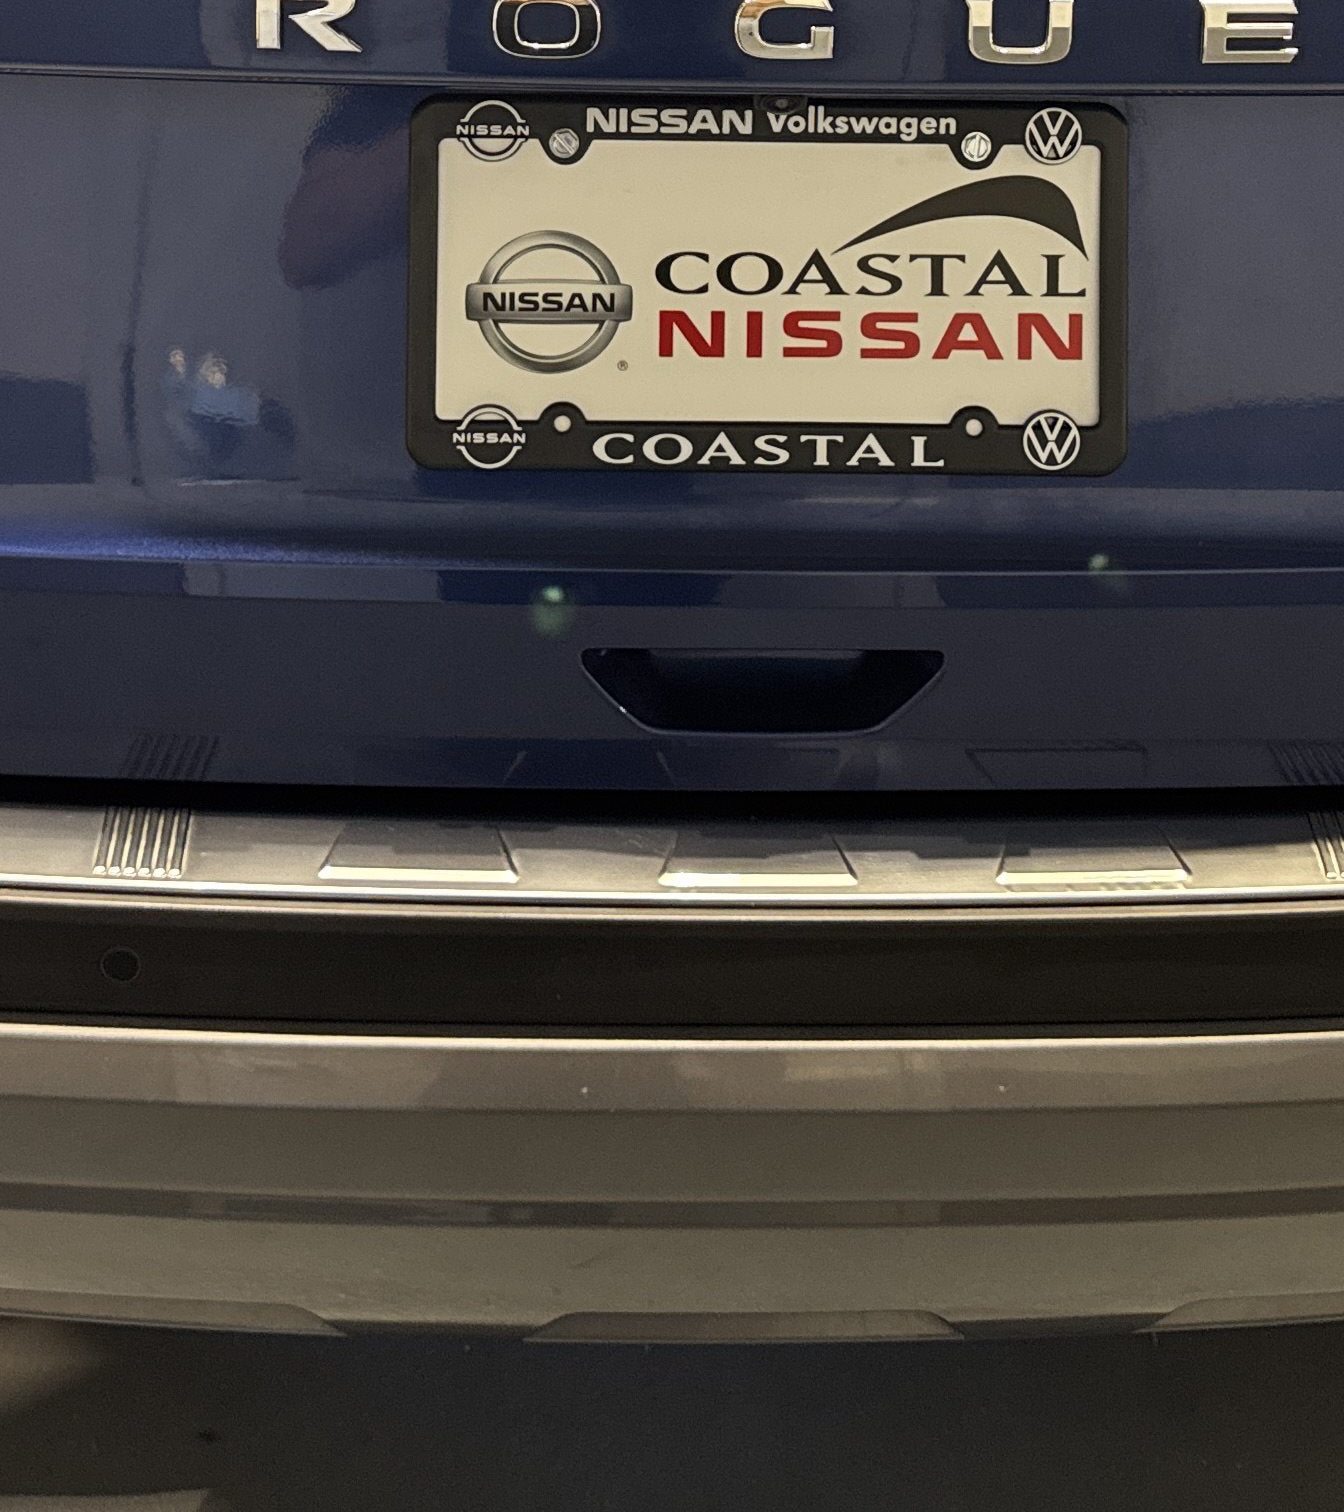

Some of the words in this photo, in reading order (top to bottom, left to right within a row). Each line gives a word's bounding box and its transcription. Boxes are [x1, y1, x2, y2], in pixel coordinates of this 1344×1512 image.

[456, 123, 529, 138] NISSAN
[586, 107, 753, 135] NISSAN
[767, 105, 958, 141] Volkswagen
[654, 248, 1087, 297] COASTAL
[482, 292, 616, 313] NISSAN
[658, 310, 1084, 361] NISSAN
[452, 430, 526, 445] NISSAN
[592, 432, 944, 466] COASTAL
